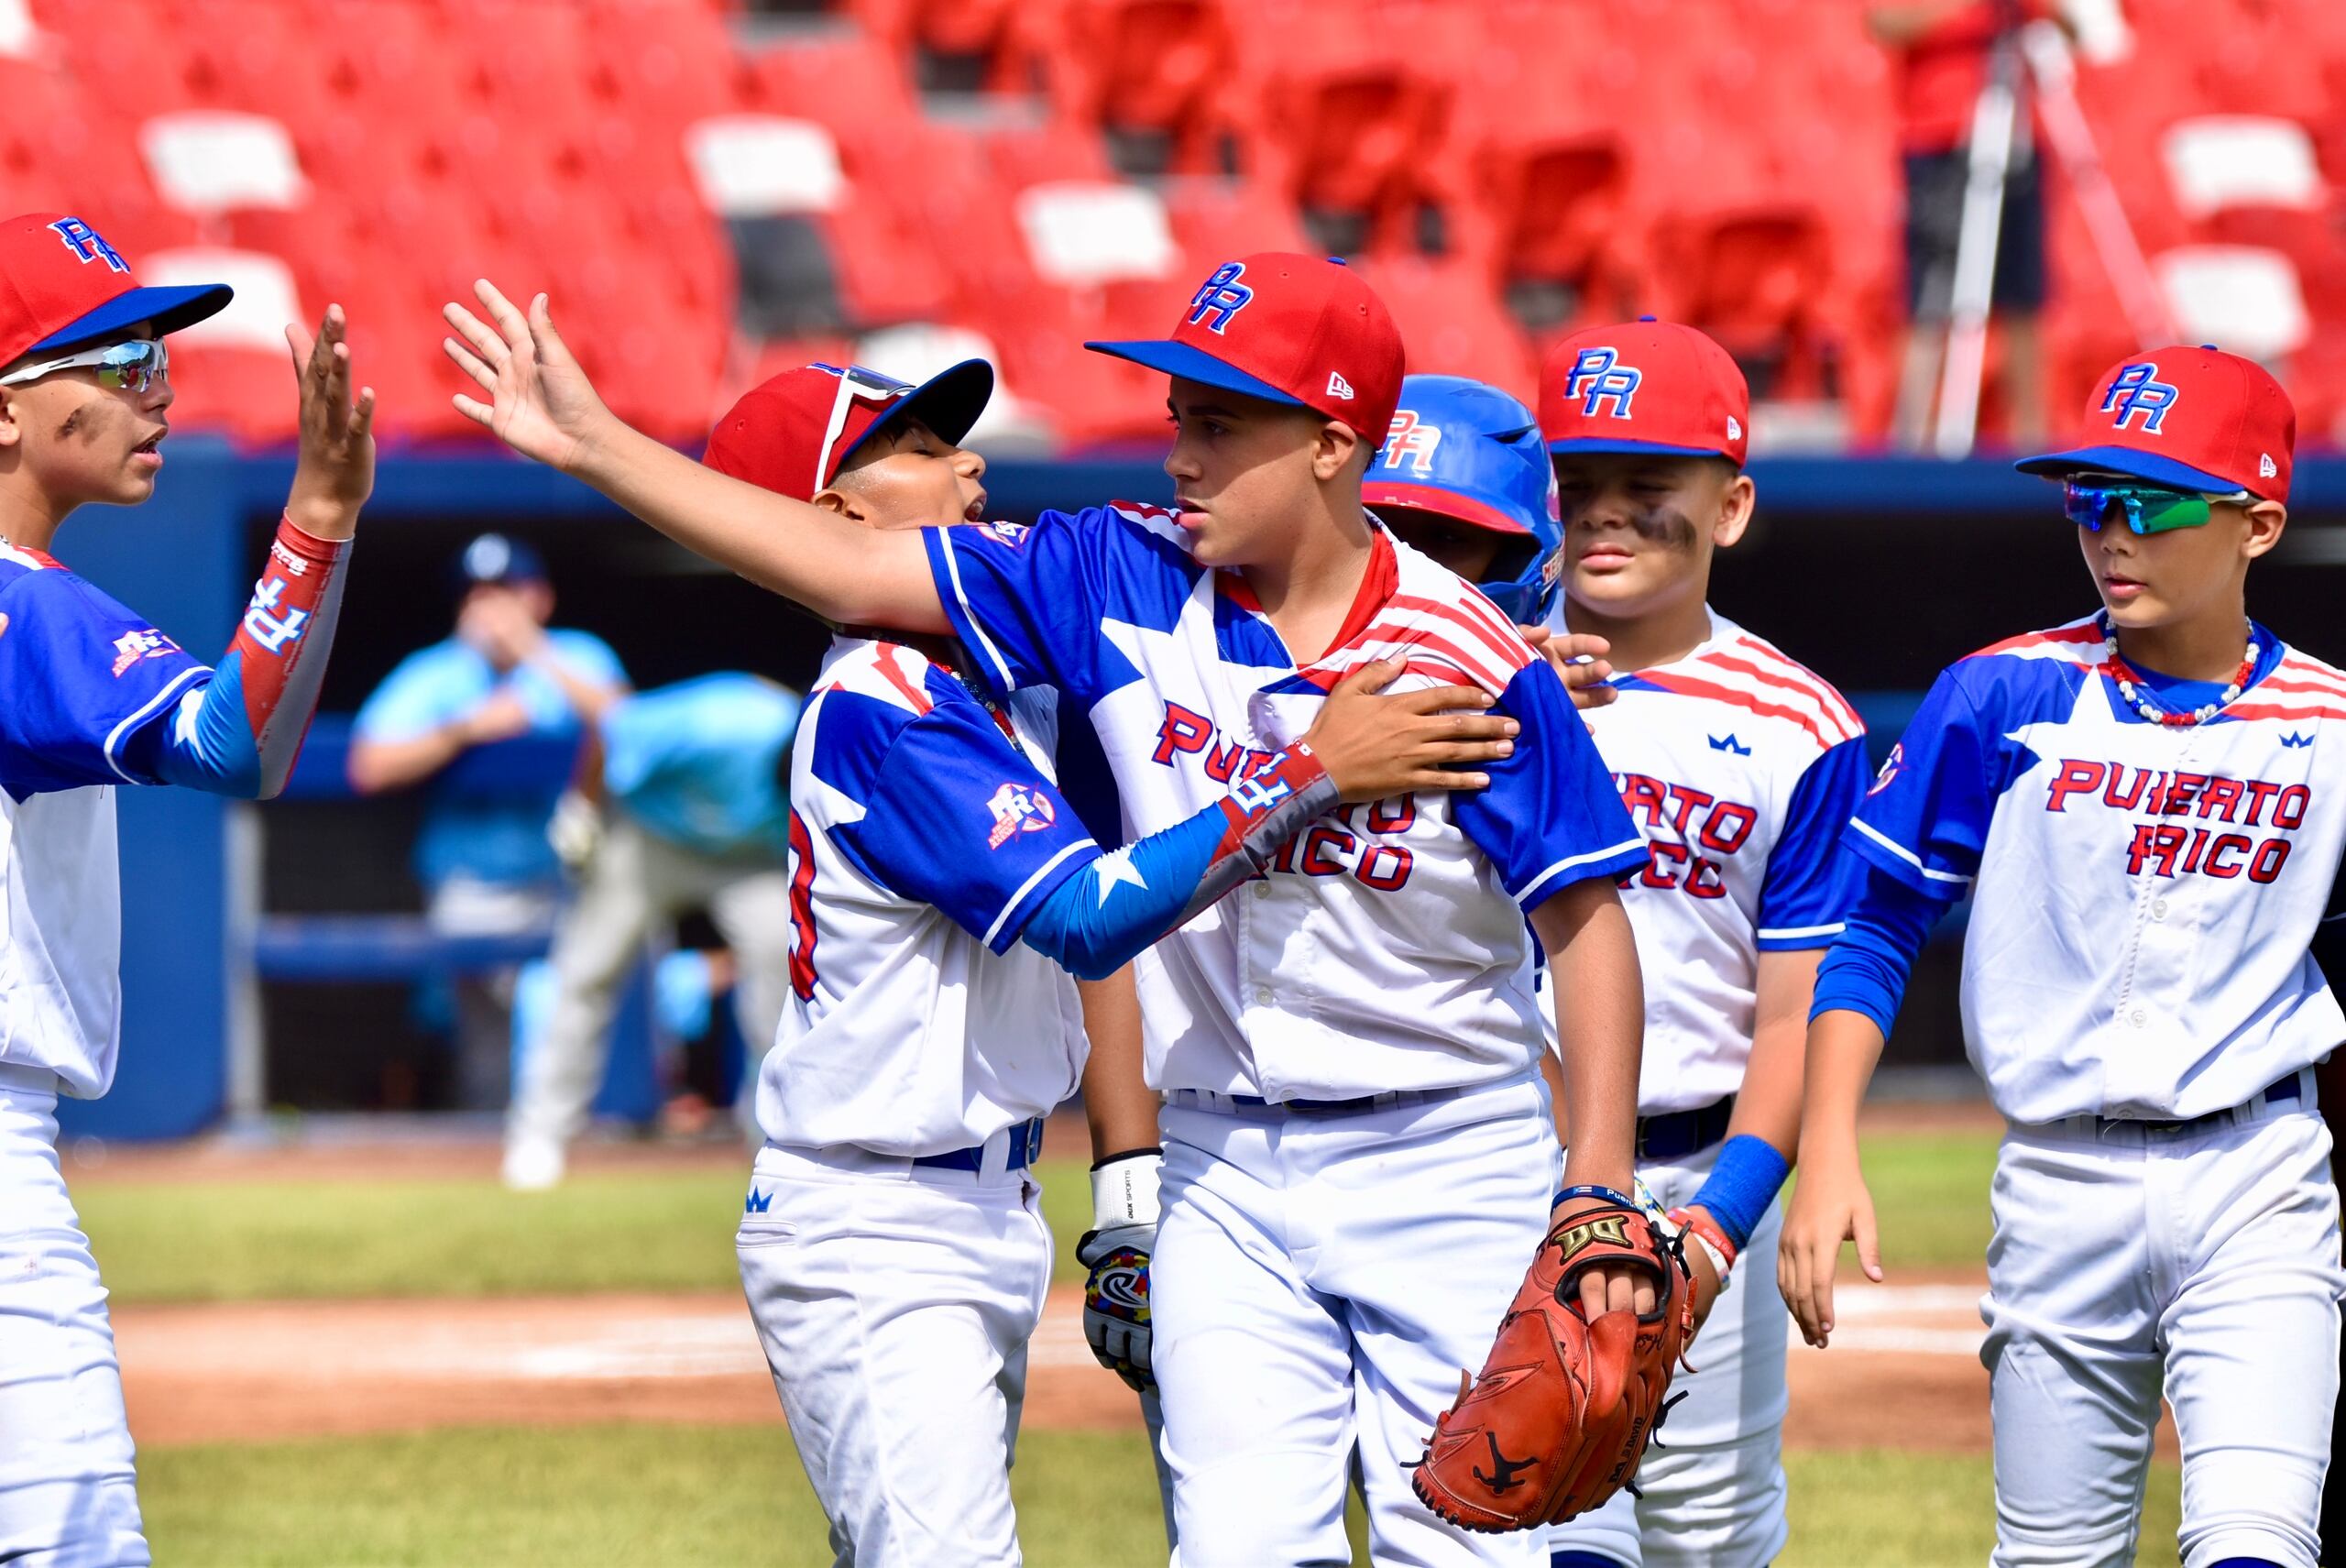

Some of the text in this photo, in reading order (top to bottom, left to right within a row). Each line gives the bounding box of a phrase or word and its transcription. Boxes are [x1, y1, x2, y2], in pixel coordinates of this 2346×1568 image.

[1189, 261, 1255, 335] PR
[1563, 346, 1643, 421] PR
[2099, 363, 2179, 435] PR
[2046, 758, 2312, 831] PUERTO
[2126, 823, 2293, 885] RICO
